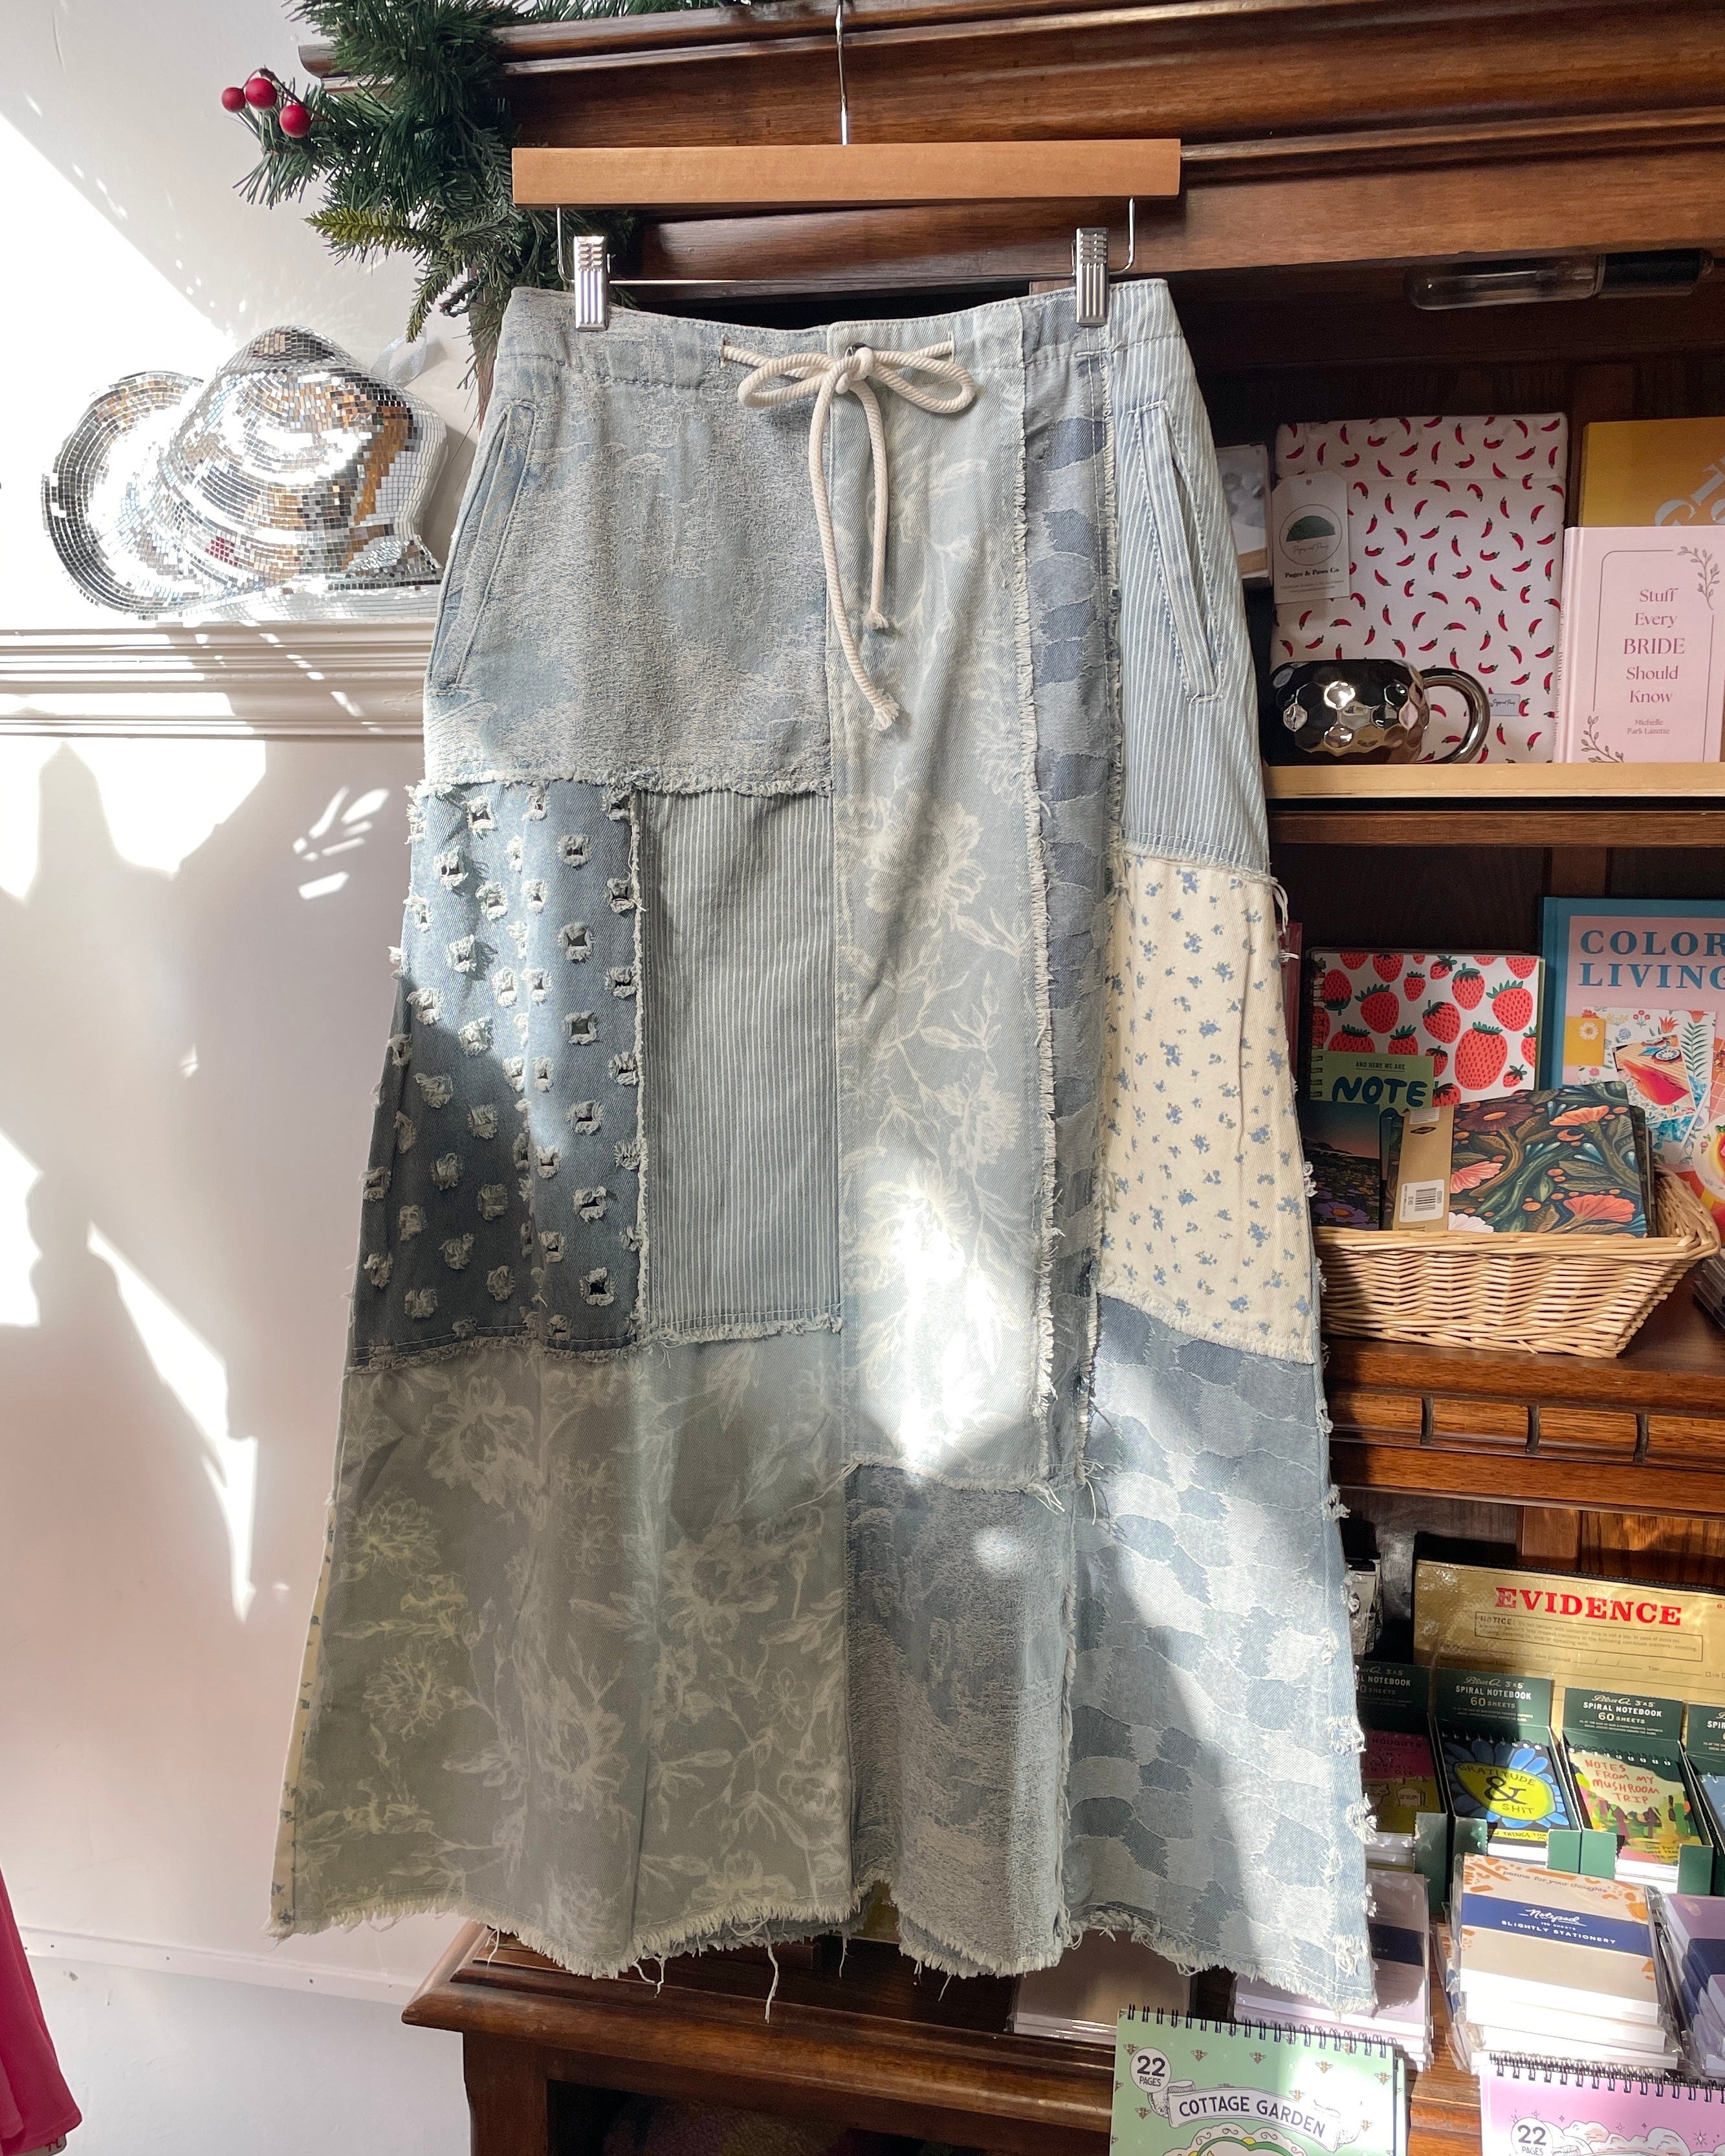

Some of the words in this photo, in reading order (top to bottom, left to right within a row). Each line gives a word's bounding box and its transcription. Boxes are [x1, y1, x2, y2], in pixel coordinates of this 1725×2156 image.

[1639, 588, 1679, 602] Stuff
[1634, 613, 1677, 628] Every
[1623, 638, 1685, 654] BRIDE
[1626, 665, 1678, 679] Should
[1629, 690, 1673, 703] Know
[1332, 1076, 1427, 1107] NOTE
[1495, 1587, 1682, 1626] EVIDENCE
[1367, 1676, 1411, 1686] NOTEBOOK
[1455, 1685, 1484, 1695] SPIRAL
[1487, 1688, 1532, 1700] NOTEBOOK
[1470, 1697, 1486, 1706] 60
[1583, 1701, 1613, 1711] SPIRAL
[1616, 1706, 1662, 1717] NOTEBOOK
[1598, 1711, 1615, 1721] 60
[1616, 1715, 1645, 1724] SHEETS
[1585, 1759, 1626, 1772] NOTES
[1458, 1764, 1537, 1786] GRATITUDE
[1595, 1770, 1629, 1780] FROM
[1636, 1776, 1654, 1784] MY
[1484, 1776, 1528, 1805] &
[1592, 1779, 1660, 1794] MUSHROOM
[1612, 1792, 1649, 1804] TRIP
[1502, 1803, 1535, 1814] SHIT
[1502, 1871, 1531, 1880] penne
[1546, 1878, 1569, 1887] your
[1570, 1882, 1608, 1893] thoughts
[1525, 1909, 1580, 1924] Notepad
[1501, 1920, 1549, 1933] SLIGHTLY
[1553, 1929, 1616, 1944] STATIONERY
[1136, 2054, 1166, 2078] 22
[1139, 2076, 1161, 2087] PAGES
[1179, 2095, 1250, 2117] COTTAGE
[1257, 2099, 1326, 2138] GARDEN
[1517, 2124, 1546, 2146] 22
[1521, 2145, 1544, 2156] PAGES
